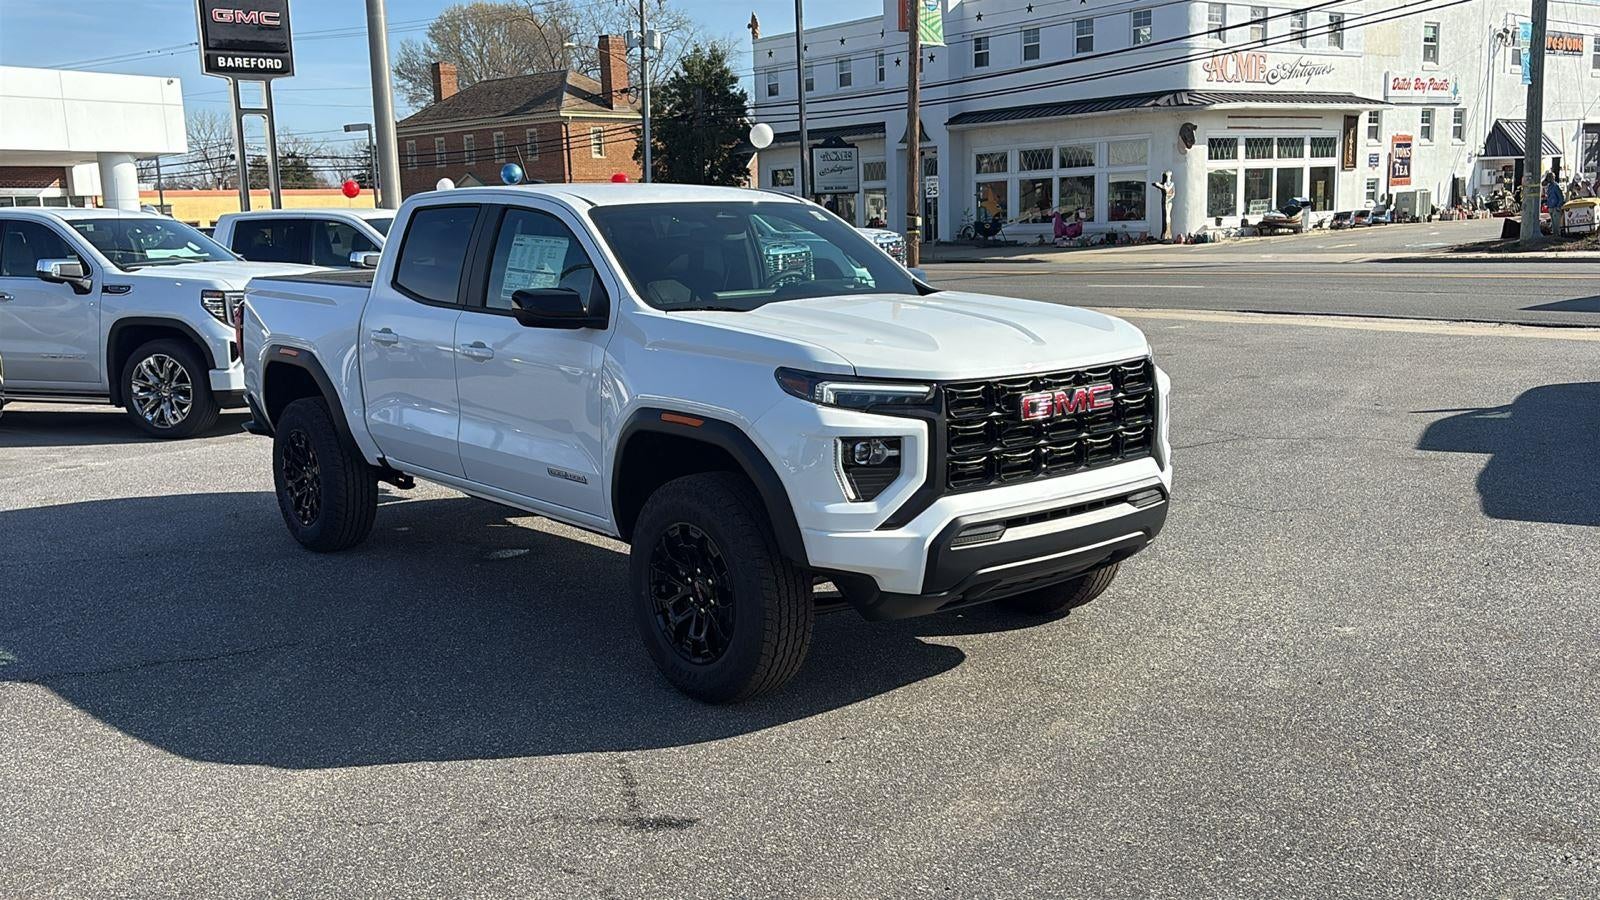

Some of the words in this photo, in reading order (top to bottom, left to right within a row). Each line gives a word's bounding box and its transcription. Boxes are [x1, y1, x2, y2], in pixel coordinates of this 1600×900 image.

[212, 8, 281, 26] GMC
[1545, 36, 1583, 51] restone
[217, 56, 282, 69] BAREFORD
[1203, 52, 1267, 83] ACME
[1266, 56, 1335, 85] Antiques
[1392, 77, 1411, 91] Dutch
[1413, 77, 1427, 94] Boy
[1428, 77, 1450, 91] Paints
[1394, 163, 1409, 176] TEA
[927, 187, 938, 195] 25
[1021, 383, 1114, 421] GMC
